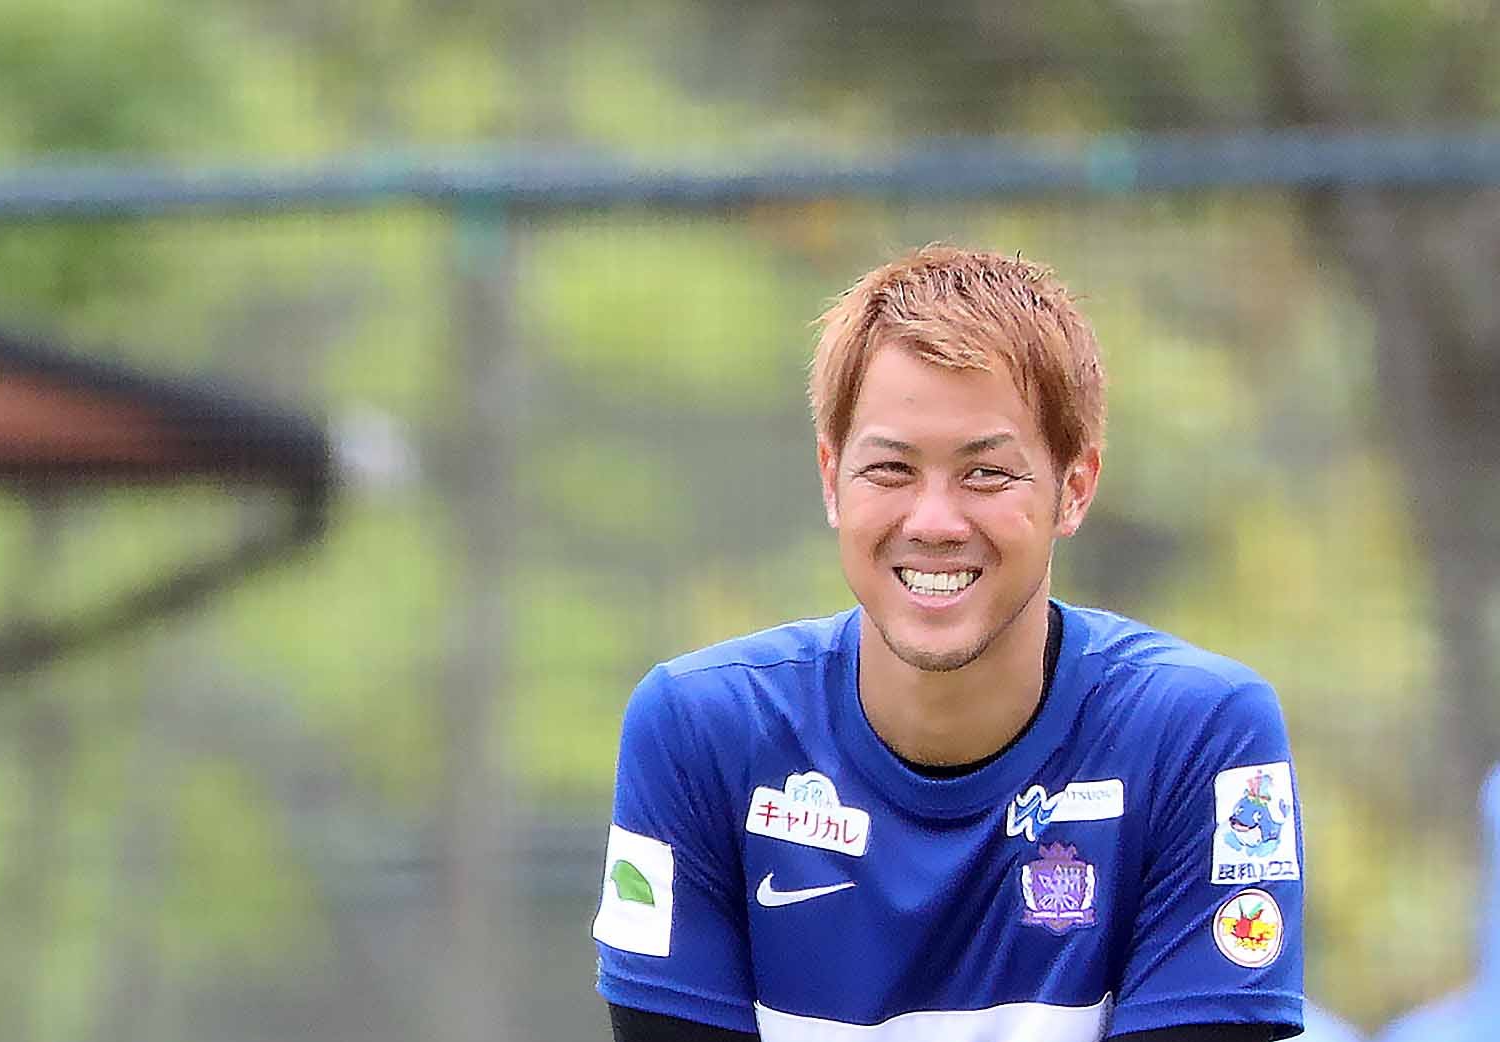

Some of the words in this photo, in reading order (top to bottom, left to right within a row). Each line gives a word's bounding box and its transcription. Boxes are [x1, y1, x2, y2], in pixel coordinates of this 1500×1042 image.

[755, 800, 860, 845] キャリカレ
